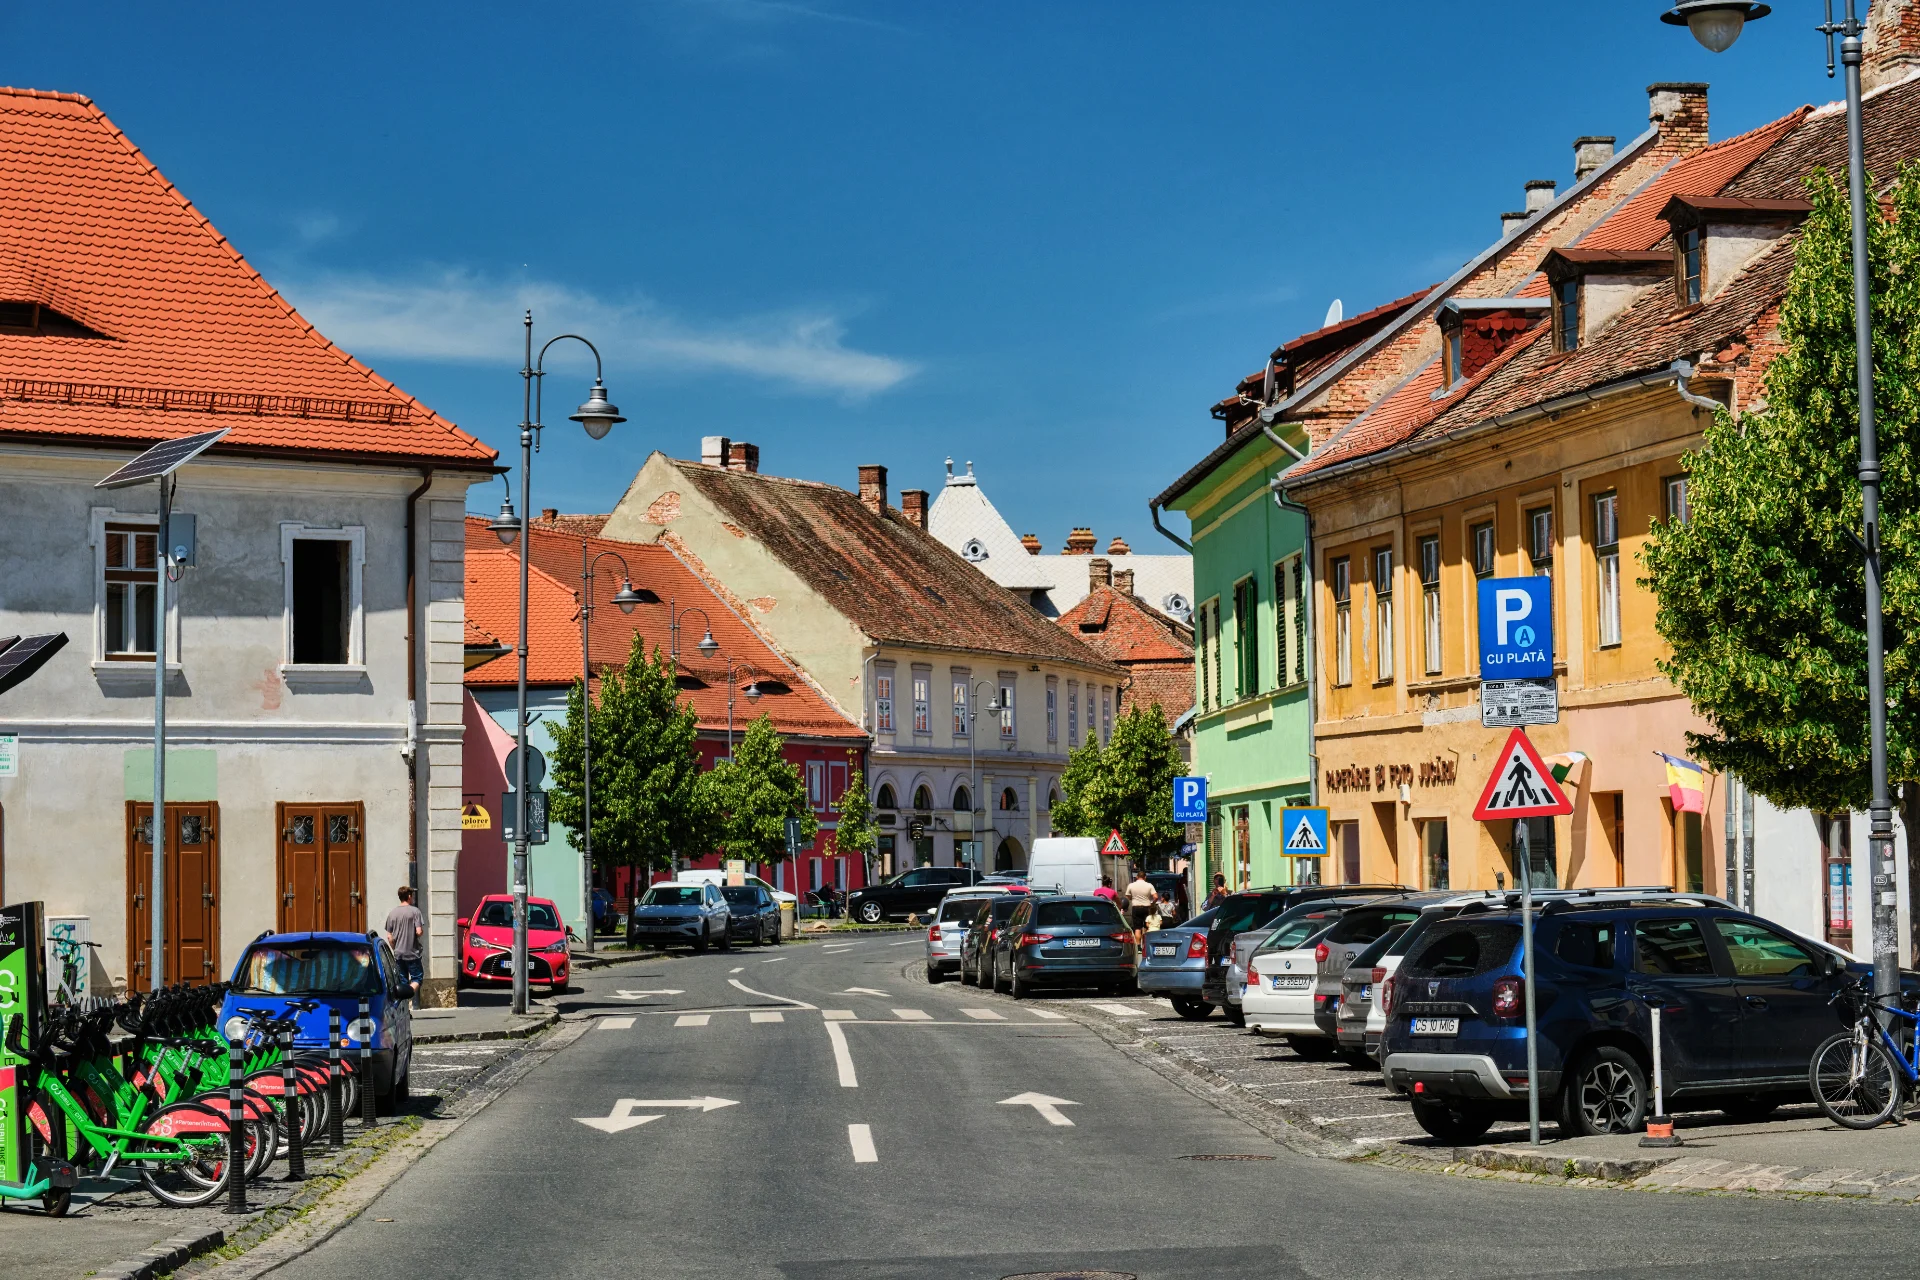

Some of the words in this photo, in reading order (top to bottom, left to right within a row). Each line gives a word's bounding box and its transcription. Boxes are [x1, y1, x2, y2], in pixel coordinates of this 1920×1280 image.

[1495, 588, 1533, 646] P
[1519, 628, 1531, 645] A
[1486, 653, 1504, 665] CU
[1506, 648, 1546, 664] PLATĂ
[1183, 781, 1199, 807] P
[1196, 800, 1203, 809] A
[1415, 1019, 1427, 1032] CS
[1430, 1019, 1438, 1032] 10
